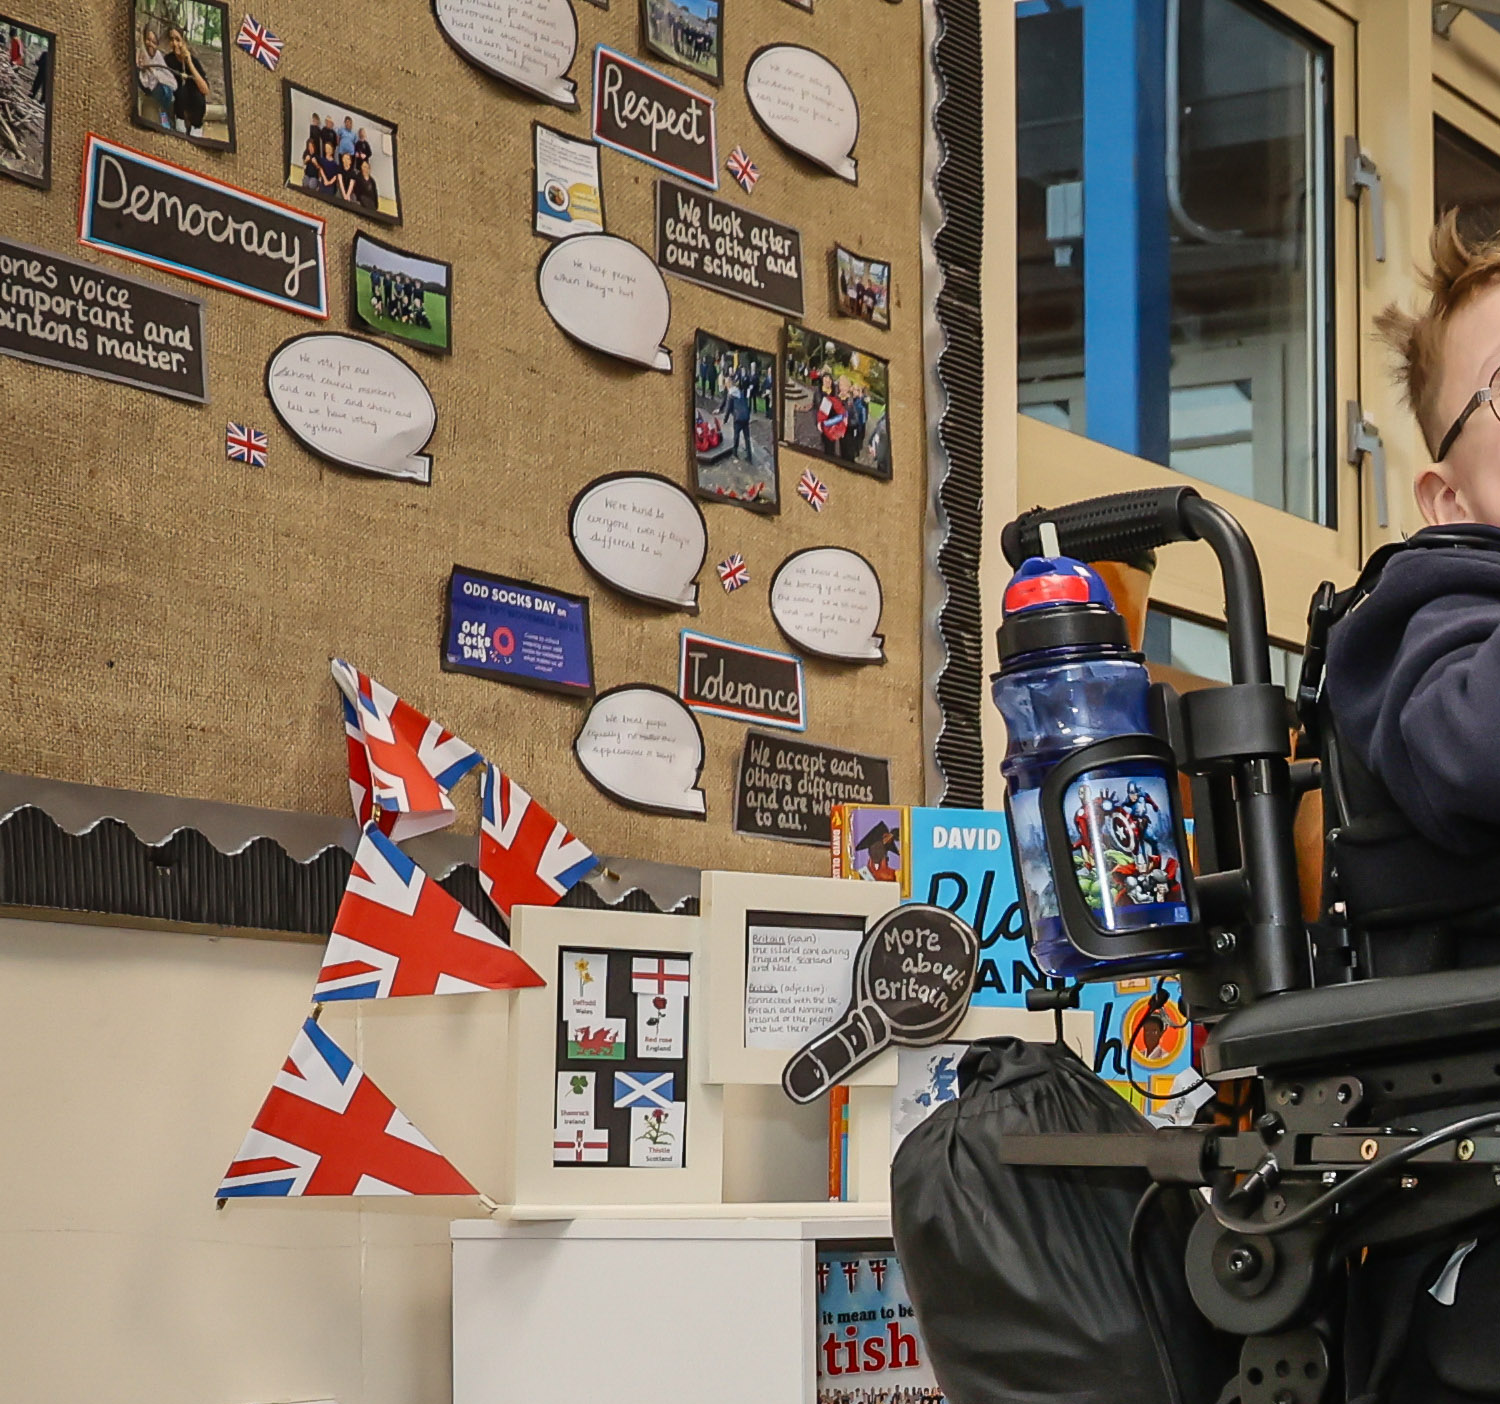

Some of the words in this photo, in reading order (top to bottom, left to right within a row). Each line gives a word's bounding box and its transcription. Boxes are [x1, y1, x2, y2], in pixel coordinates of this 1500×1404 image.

[604, 63, 705, 152] Respect
[97, 154, 317, 297] Democracy
[677, 192, 700, 227] We
[708, 202, 744, 239] look
[751, 227, 792, 256] after
[666, 218, 710, 249] each
[766, 256, 798, 278] and
[703, 255, 765, 288] school.
[70, 275, 132, 309] voice
[1, 279, 134, 334] important
[144, 321, 193, 351] and
[96, 334, 188, 374] matter.
[463, 582, 489, 598] ODD
[491, 588, 532, 609] SOCKS
[534, 598, 556, 614] DAY
[457, 633, 491, 648] Socks
[462, 620, 486, 636] Odd
[463, 646, 487, 663] Day
[689, 652, 799, 715] Tolerance
[750, 740, 770, 767] We
[776, 751, 826, 779] accept
[831, 757, 864, 780] each
[746, 790, 778, 809] and
[782, 797, 807, 814] are
[798, 771, 873, 802] differences
[755, 809, 772, 827] to
[932, 826, 1001, 851] DAVID
[884, 927, 942, 954] More
[901, 952, 967, 992] about
[875, 978, 951, 1013] Britain
[646, 1044, 672, 1053] England
[822, 1311, 834, 1325] it
[837, 1309, 877, 1324] mean
[880, 1306, 895, 1319] to
[822, 1321, 921, 1376] tish
